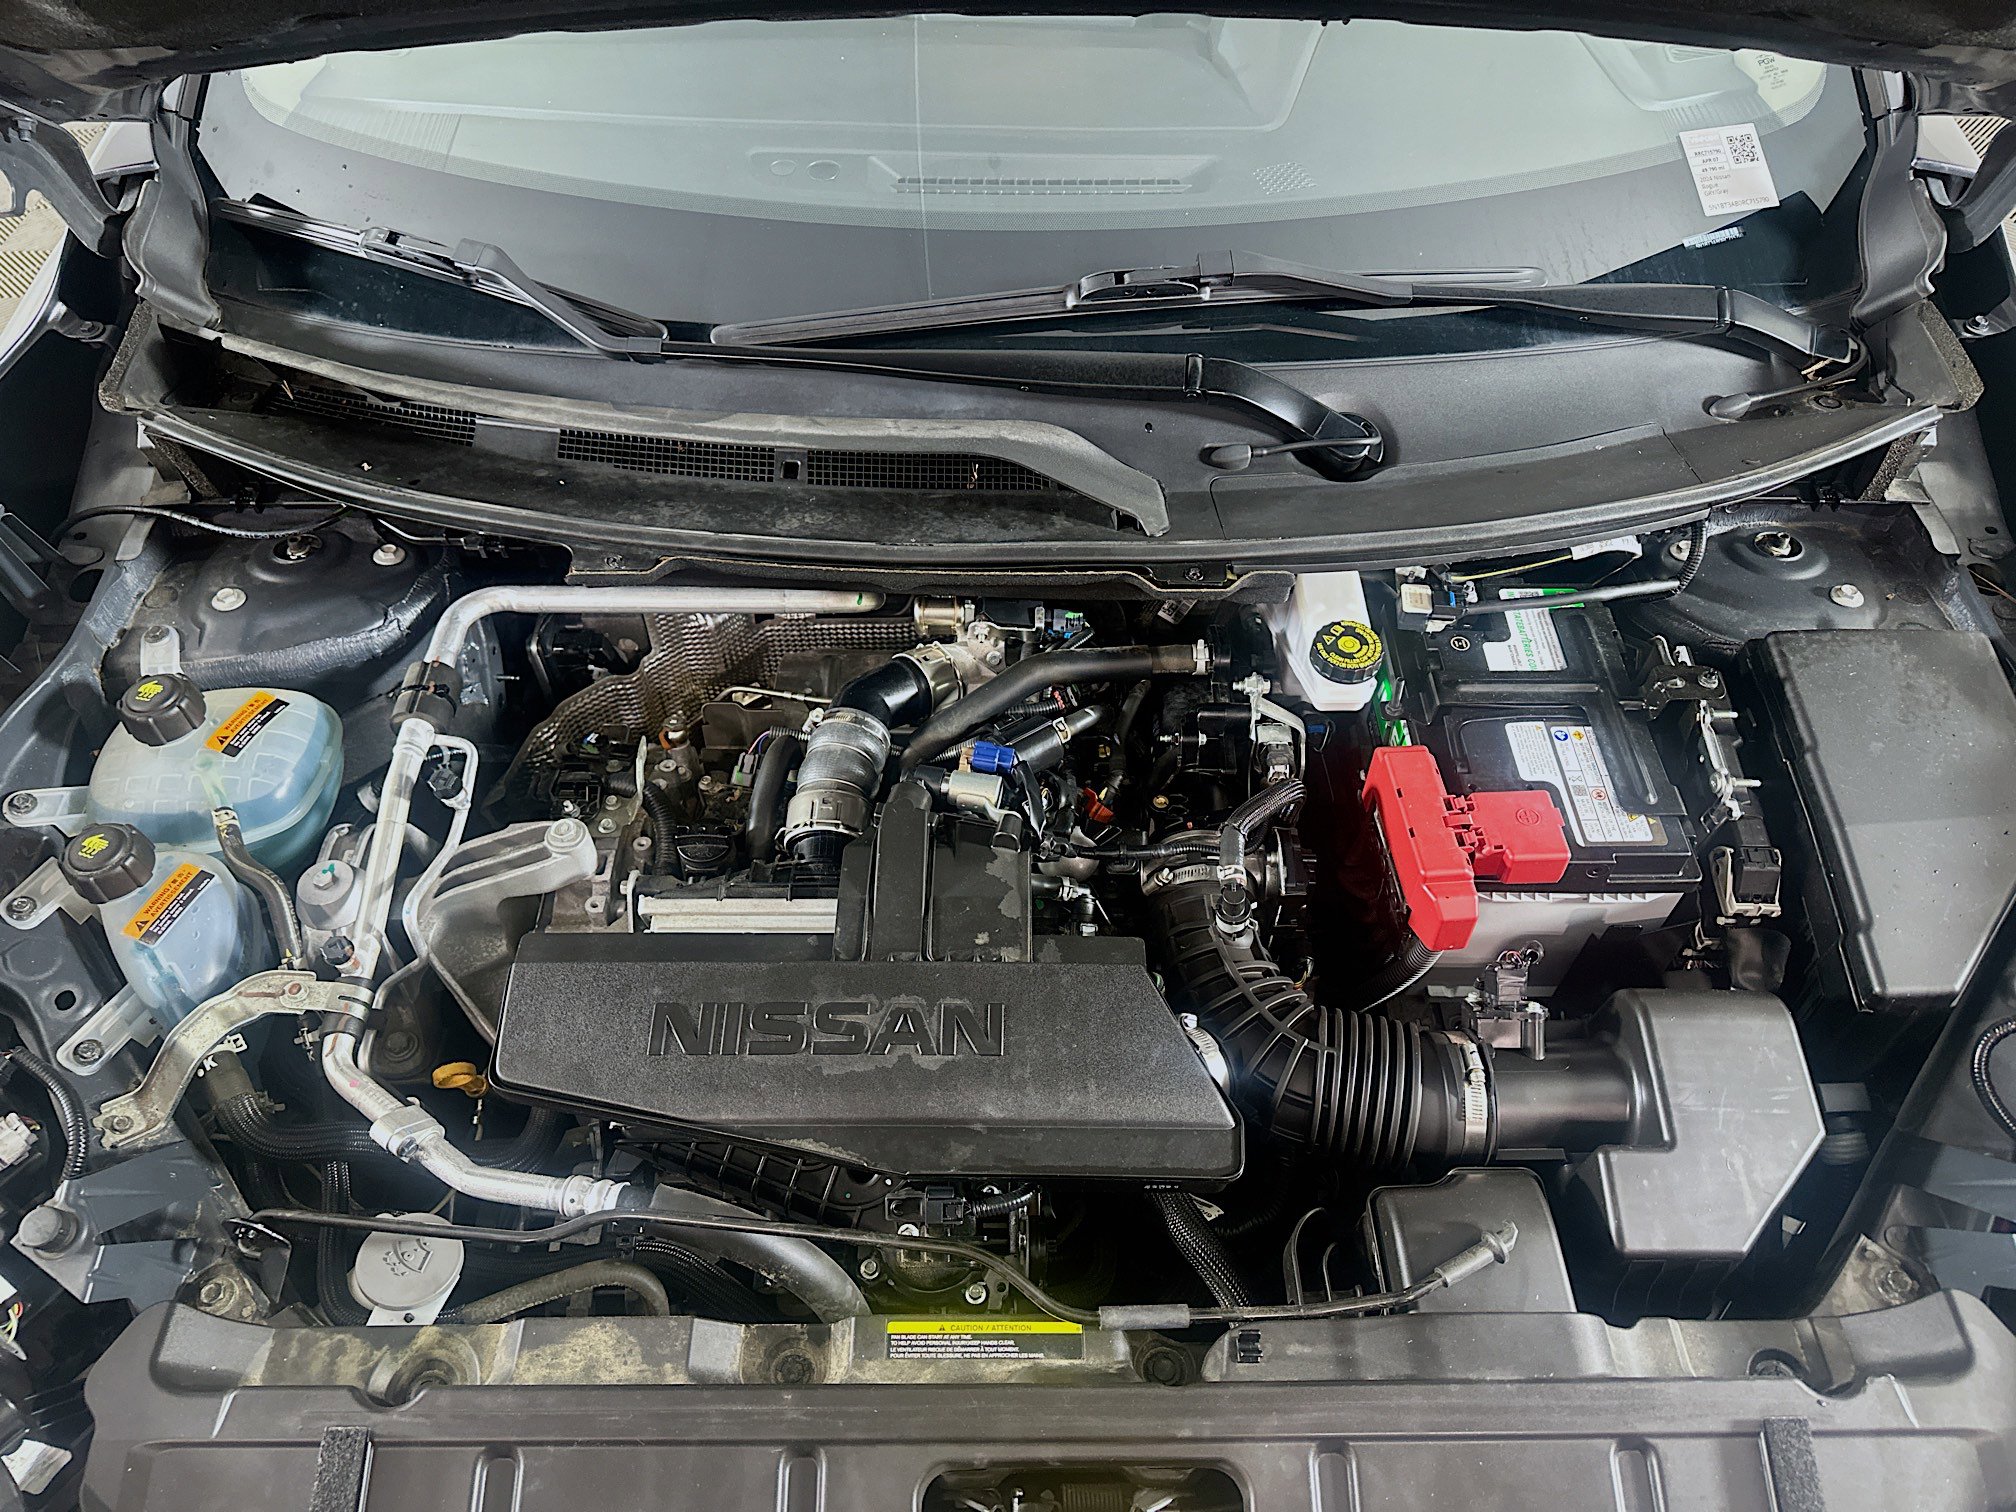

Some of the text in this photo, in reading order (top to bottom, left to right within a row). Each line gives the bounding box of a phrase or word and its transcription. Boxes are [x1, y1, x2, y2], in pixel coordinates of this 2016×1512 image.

[1758, 56, 1776, 66] PGW
[224, 708, 248, 732] WARNING
[230, 698, 268, 734] AVERTISSEMENT
[144, 886, 172, 915] WARNING
[150, 872, 193, 918] AVERTISSEMENT
[646, 1002, 1004, 1056] NISSAN
